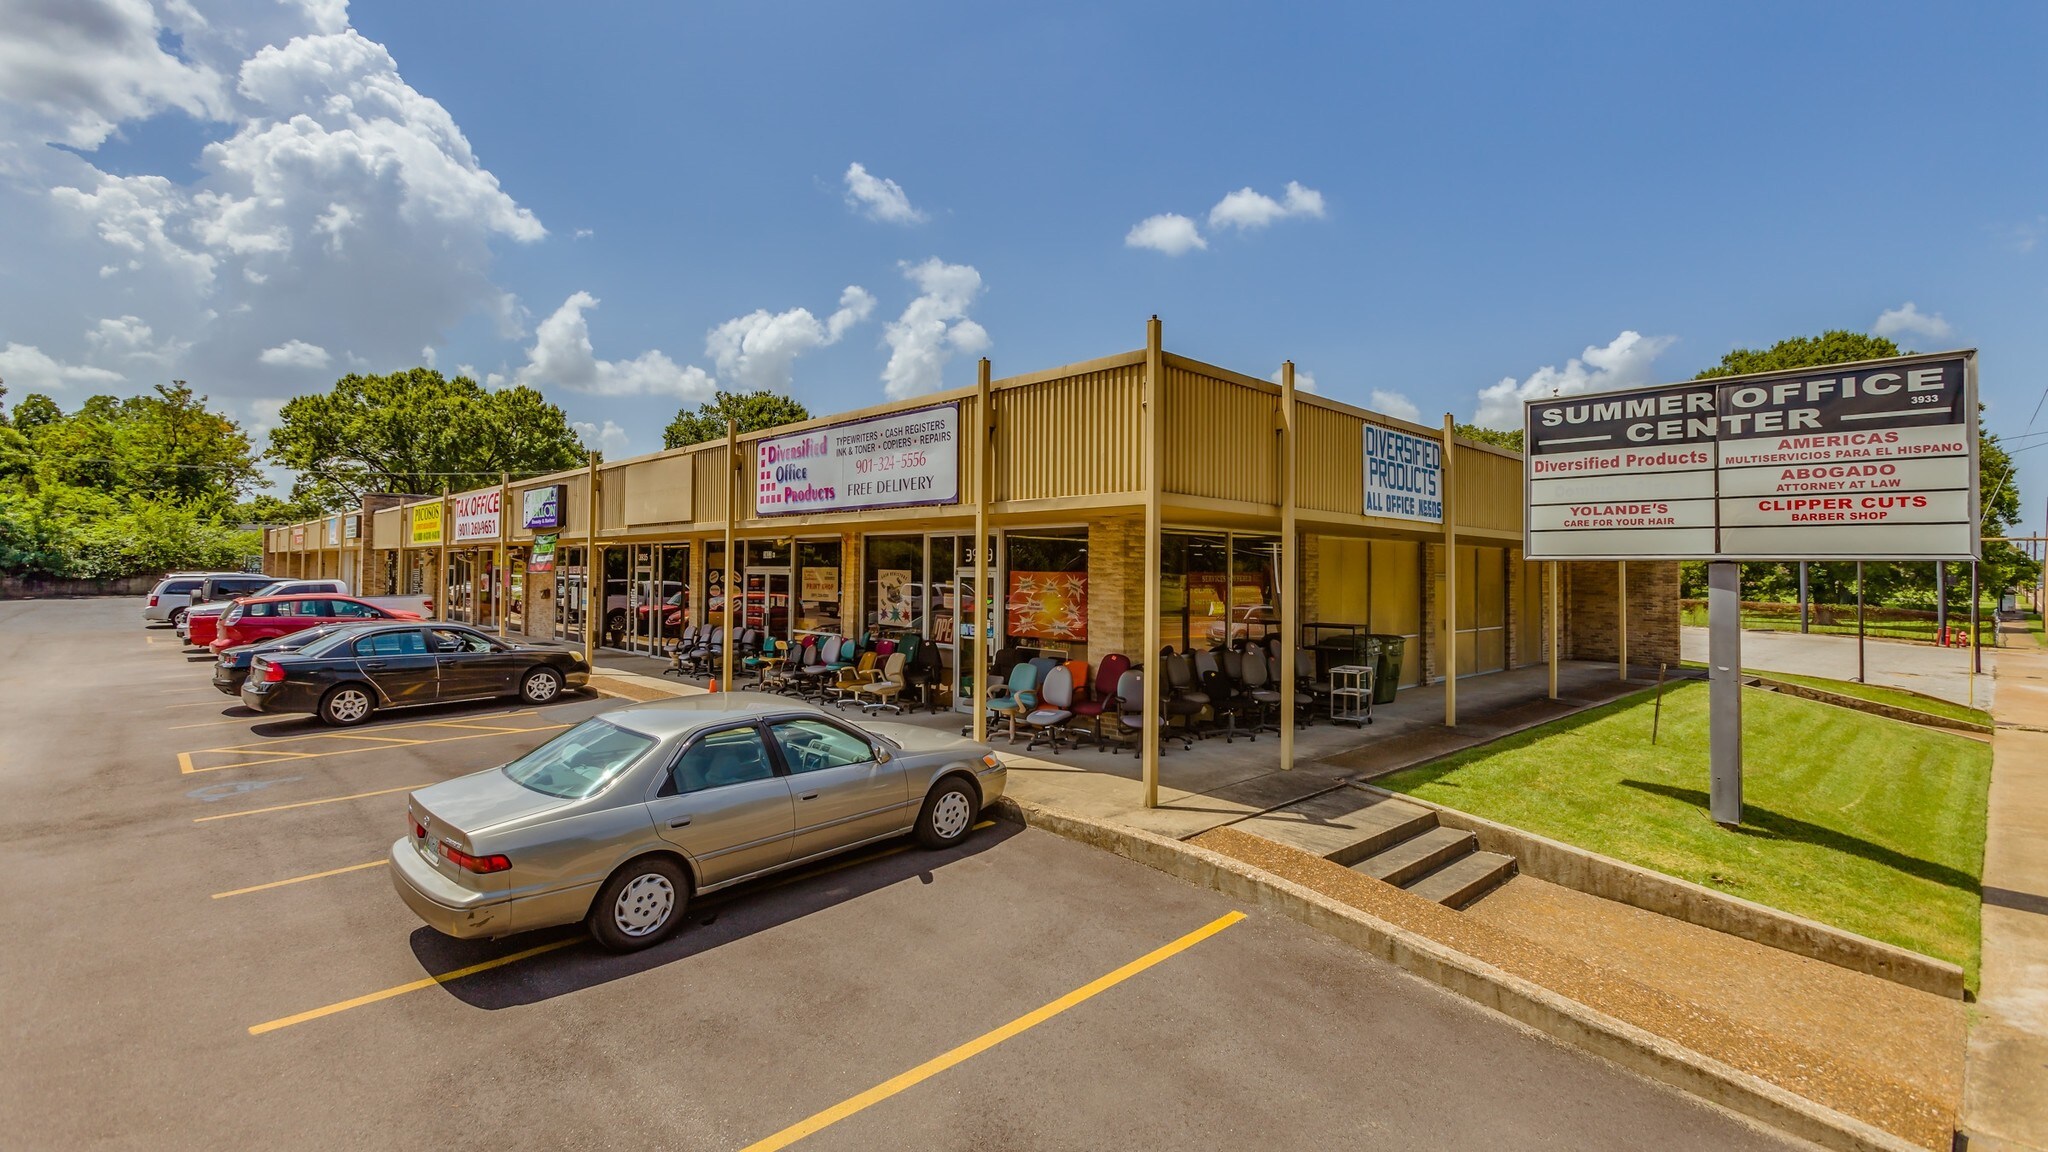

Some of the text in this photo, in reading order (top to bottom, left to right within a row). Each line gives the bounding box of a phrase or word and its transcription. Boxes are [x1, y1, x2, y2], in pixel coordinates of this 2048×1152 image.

[1542, 367, 1945, 427] SUMMER OFFICE
[1910, 394, 1939, 404] 3933
[836, 419, 946, 446] TYPEWRITERS CASH REGISTERS
[1626, 408, 1823, 442] CENTER
[768, 434, 829, 465] Diversified
[836, 431, 952, 457] INK & TONER COPIERS REPAIRS
[1366, 426, 1440, 470] DIVERSIFIED
[1777, 431, 1899, 450] AMERICAS
[856, 450, 927, 475] 901-324-5556
[1534, 450, 1708, 473] Diversified Products
[1725, 442, 1963, 465] MULTISERVICIOS PARA EL HISPANO
[775, 464, 808, 484] Office
[1369, 456, 1436, 497] PRODUCTS
[1780, 463, 1896, 480] ABOGADO
[784, 482, 836, 505] Products
[847, 474, 935, 497] FREE DELIVERY
[1776, 478, 1901, 492] ATTORNEY AT LAW
[456, 498, 470, 518] TAX
[471, 492, 499, 516] OFFICE
[1366, 490, 1442, 519] ALL OFFICE NEEDS
[1569, 503, 1669, 517] YOLANDE'S
[1758, 495, 1927, 511] CLIPPER CUTS
[471, 519, 496, 536] 260-9651
[1564, 519, 1590, 527] CARE
[1616, 518, 1645, 526] YOUR
[1648, 517, 1675, 525] HAIR
[1791, 511, 1888, 522] BARBER SHOP
[936, 617, 954, 642] OPE
